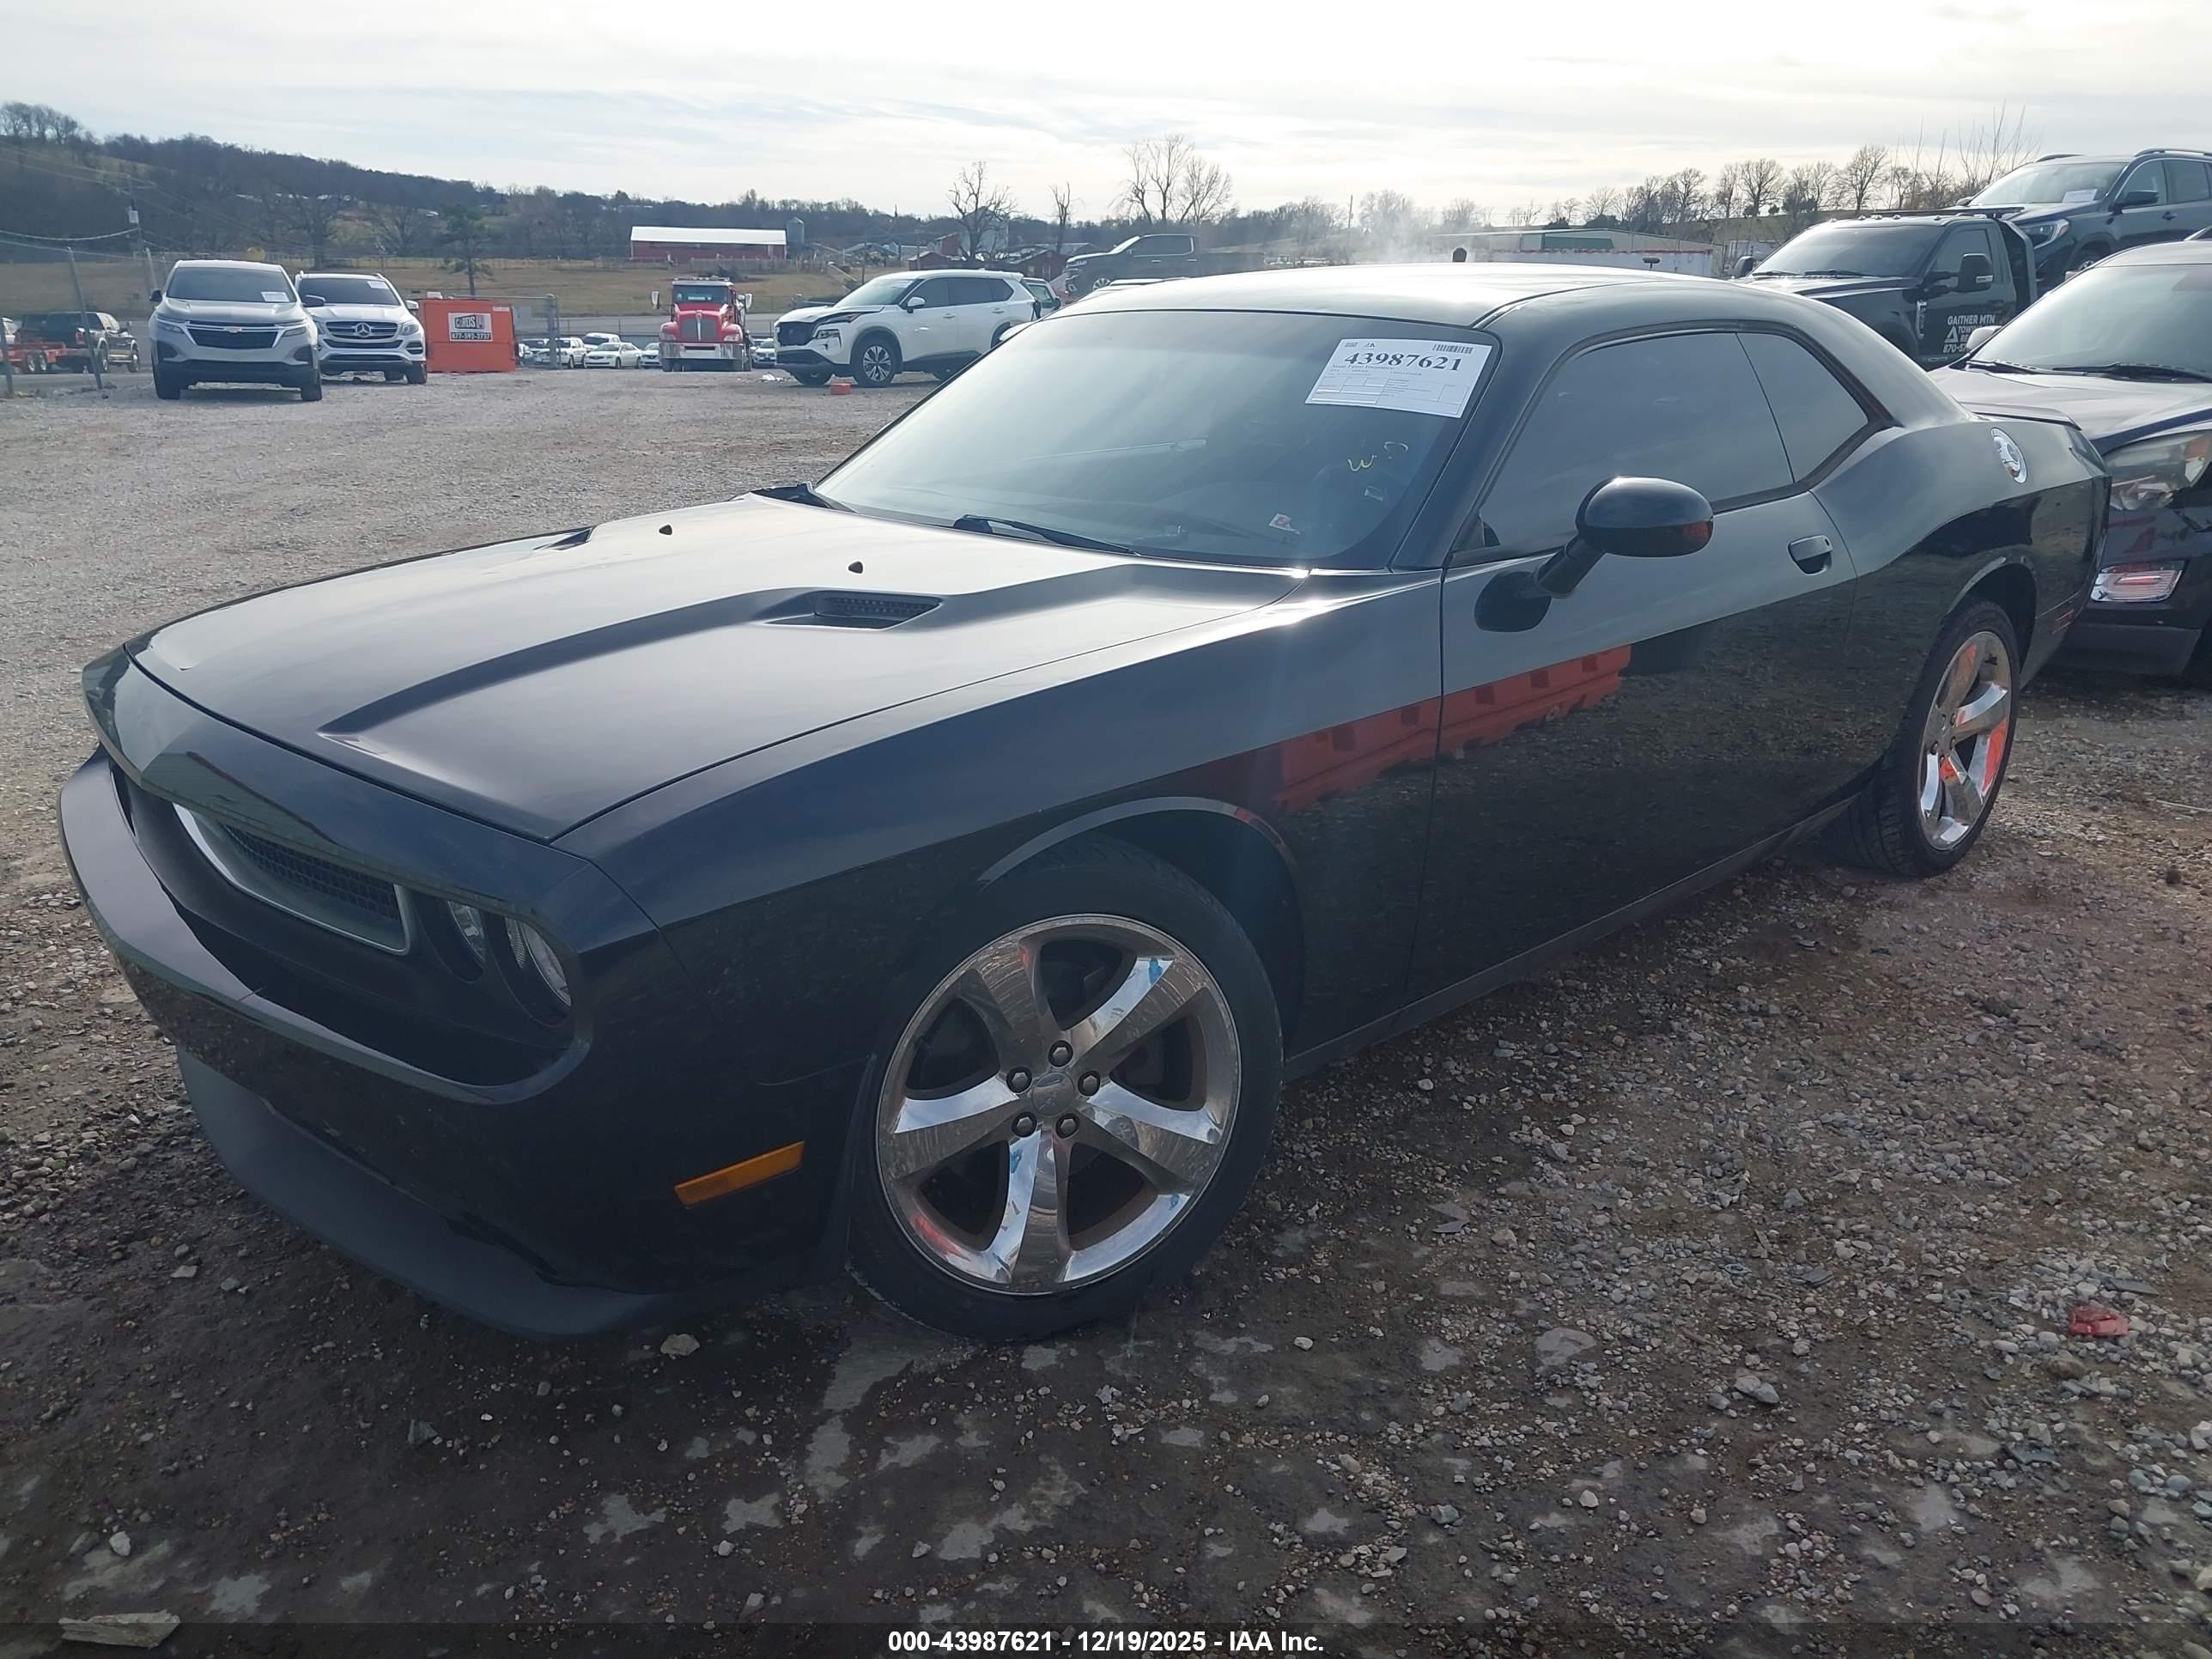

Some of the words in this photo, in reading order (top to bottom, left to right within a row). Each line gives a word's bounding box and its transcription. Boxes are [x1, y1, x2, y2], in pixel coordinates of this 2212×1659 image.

[1947, 315, 1978, 325] GAITHER
[1979, 314, 1995, 324] MTN
[1344, 352, 1462, 371] 43987621
